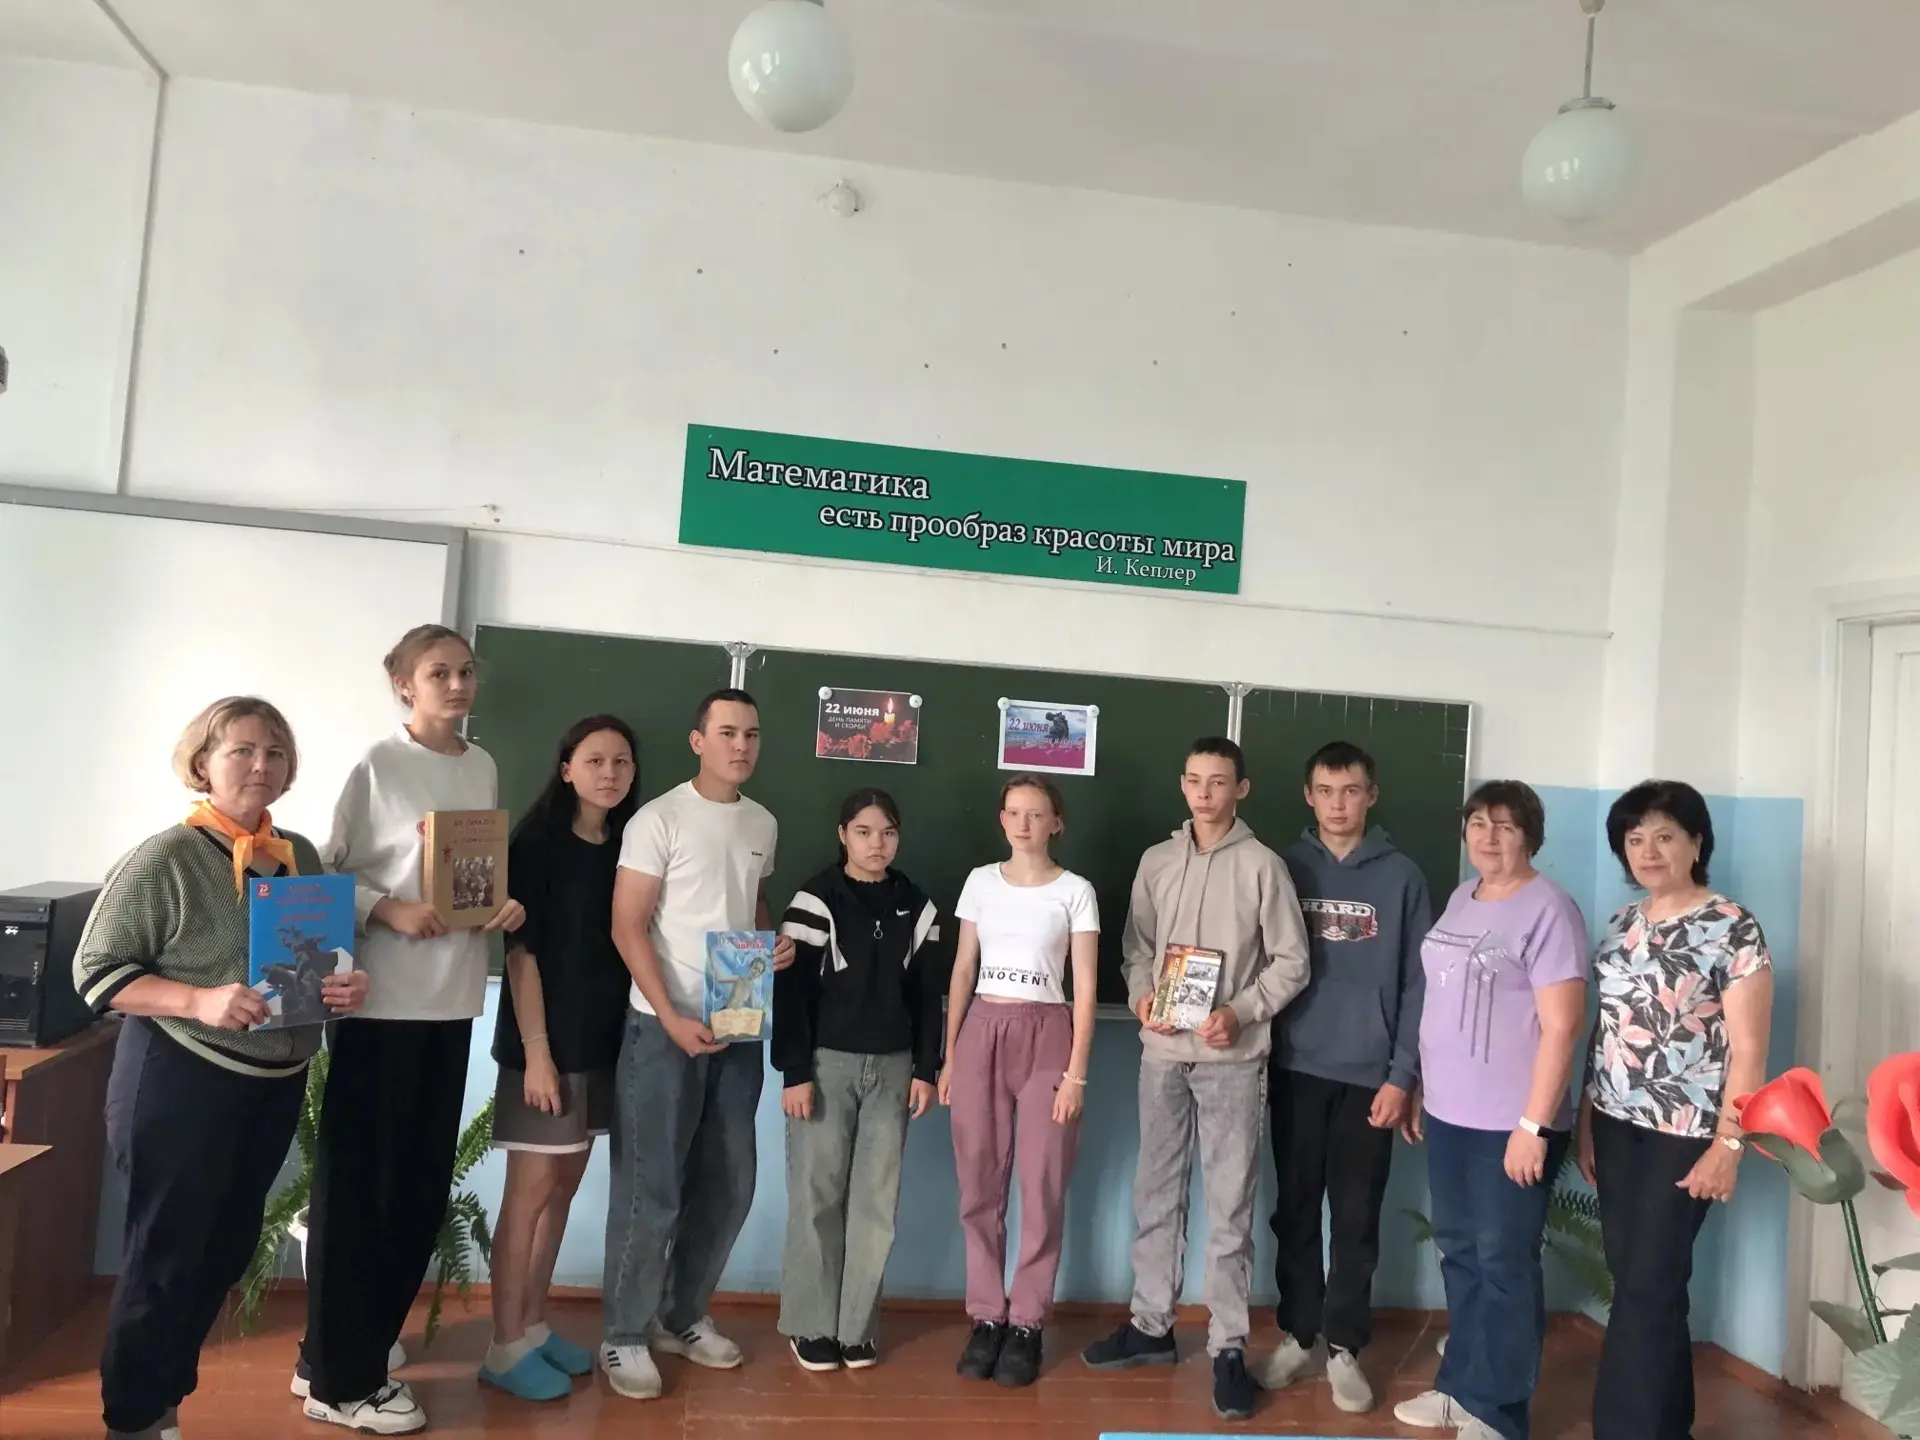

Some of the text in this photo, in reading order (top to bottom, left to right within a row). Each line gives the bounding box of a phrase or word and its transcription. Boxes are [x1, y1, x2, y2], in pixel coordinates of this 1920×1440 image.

[707, 447, 930, 499] Математика
[819, 506, 1236, 568] есть прообраз красоты мира
[1096, 556, 1197, 585] И. Кеплер
[825, 703, 840, 714] 22
[1008, 718, 1049, 733] 22 июня
